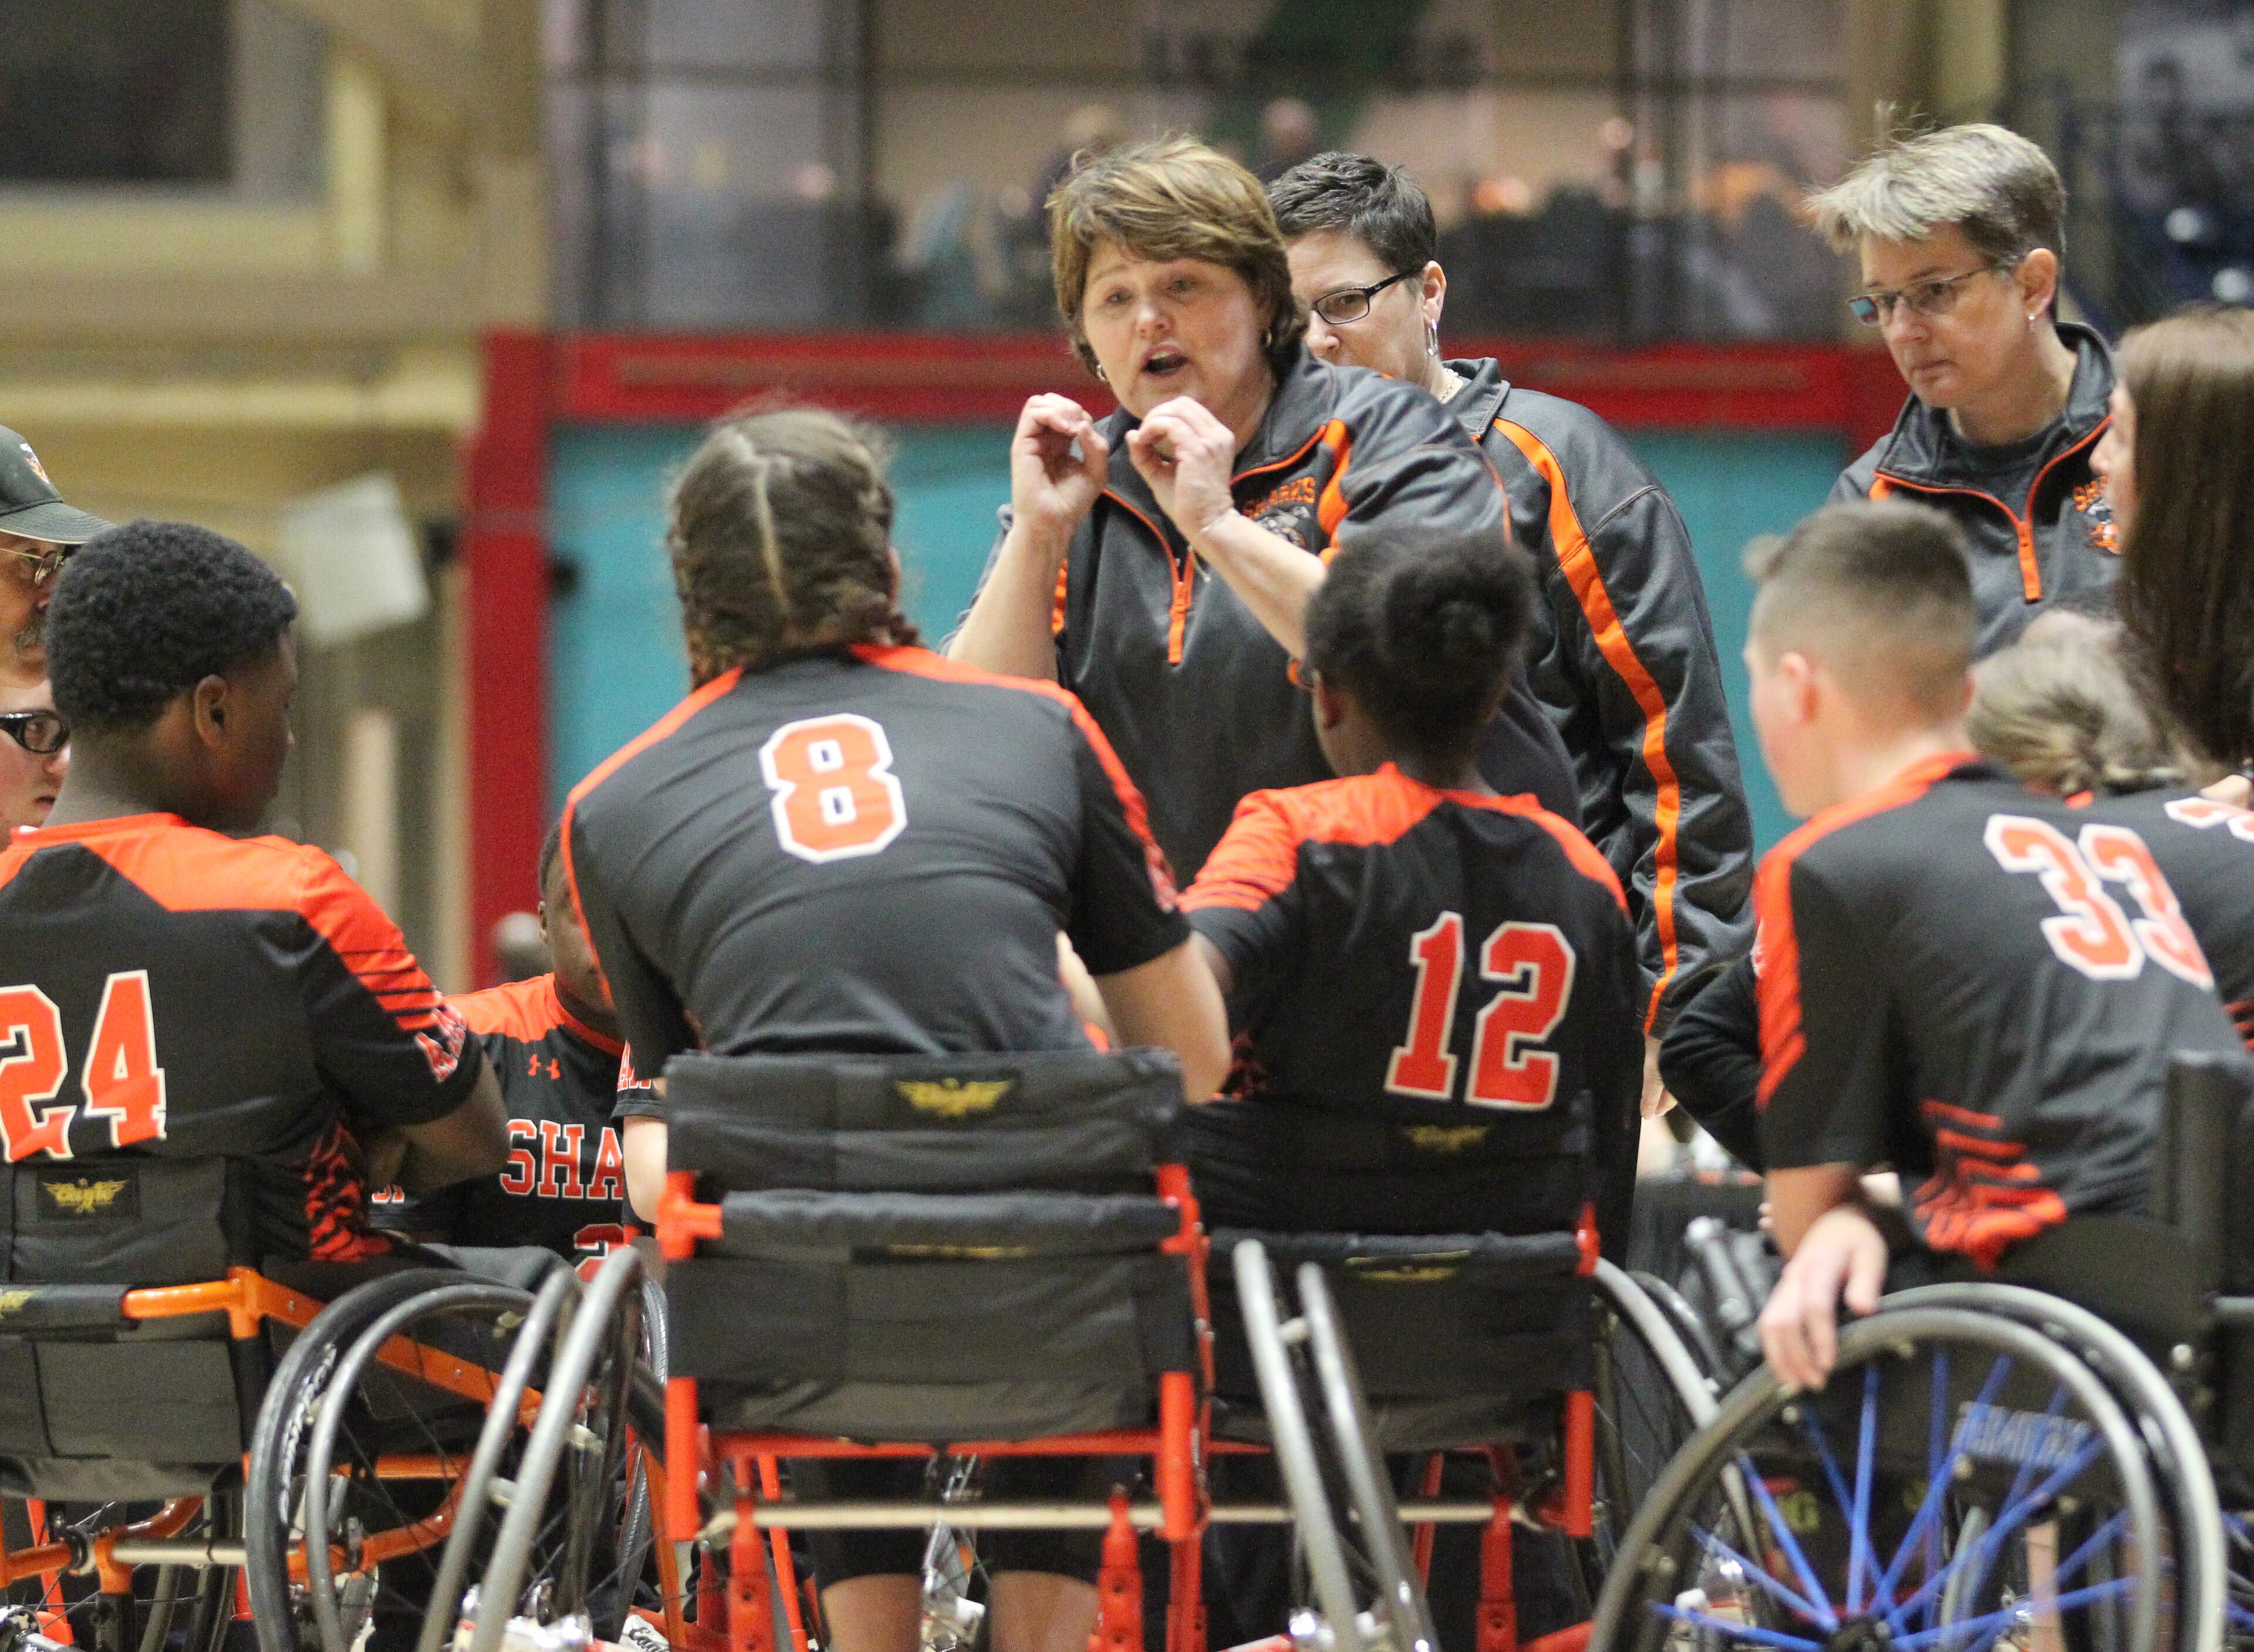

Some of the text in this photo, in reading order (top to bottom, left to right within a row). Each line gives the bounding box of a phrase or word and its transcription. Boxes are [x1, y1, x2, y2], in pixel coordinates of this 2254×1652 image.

[758, 712, 908, 864] 8
[1983, 813, 2214, 991] 33
[0, 969, 167, 1162] 24
[1384, 911, 1575, 1110] 12
